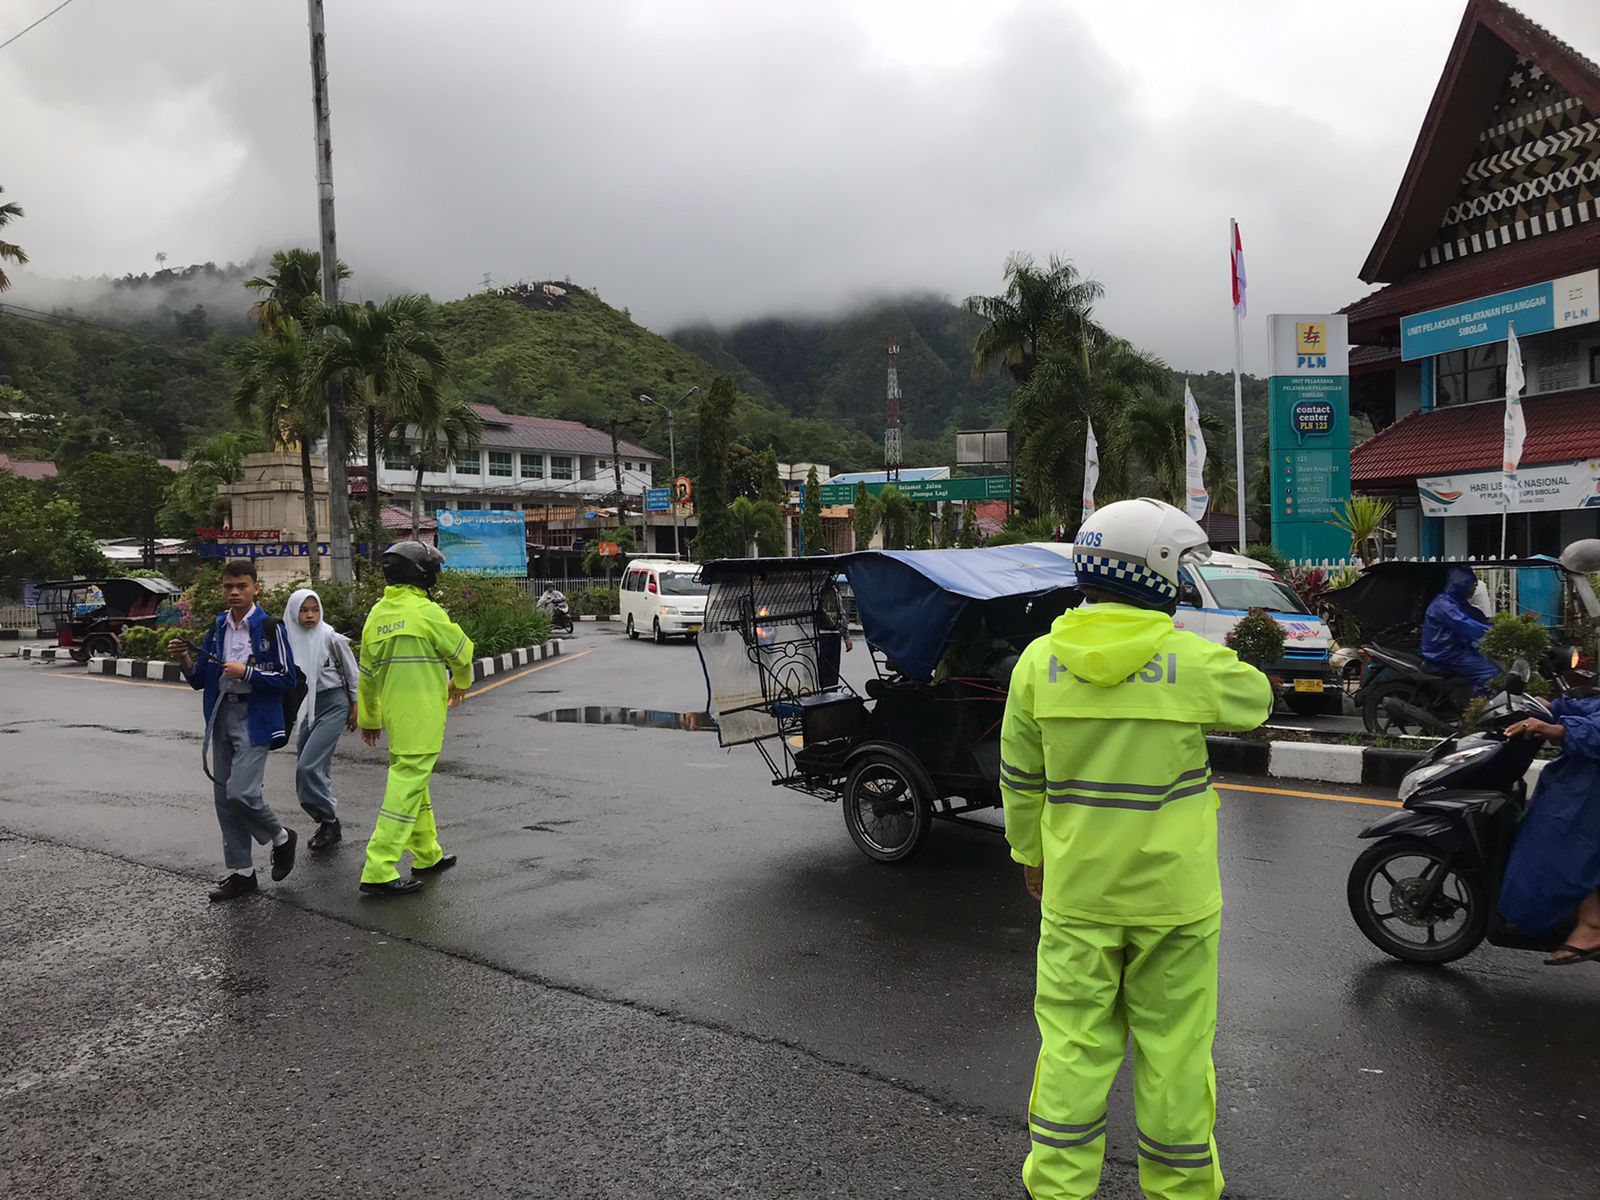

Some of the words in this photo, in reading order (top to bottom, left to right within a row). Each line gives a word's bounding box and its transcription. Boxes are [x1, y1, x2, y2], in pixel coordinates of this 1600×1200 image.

[1407, 326, 1423, 337] UNIT
[1423, 316, 1461, 334] PELAKSANA
[1461, 306, 1500, 325] PELAYANAN
[1501, 296, 1546, 314] PELANGGAN
[1564, 307, 1589, 321] PLN
[1458, 323, 1488, 337] SIBOLGA
[1297, 356, 1327, 369] PLN
[1296, 405, 1331, 413] contact
[1299, 413, 1328, 421] center
[1300, 422, 1313, 430] PLN
[1315, 422, 1328, 430] 123
[925, 482, 942, 490] Jalan
[1470, 483, 1489, 493] HARI
[1524, 477, 1570, 488] NASIONAL
[1535, 487, 1560, 496] SIBOLGA
[377, 620, 405, 635] POLISI
